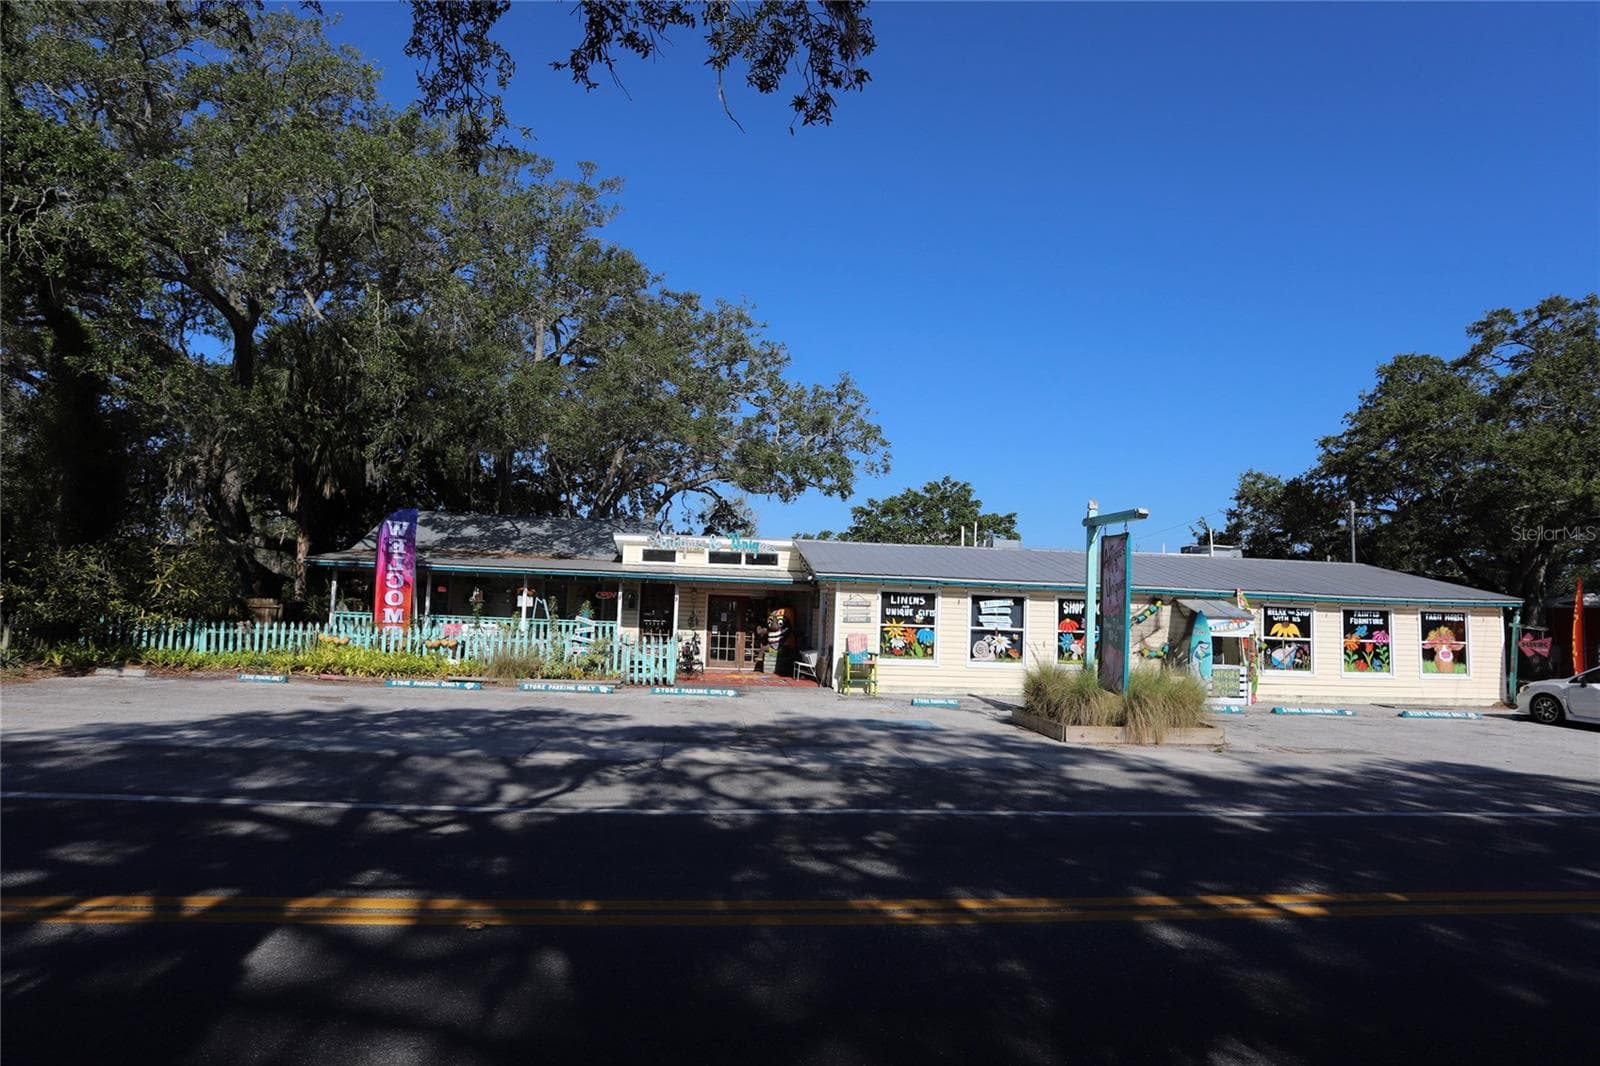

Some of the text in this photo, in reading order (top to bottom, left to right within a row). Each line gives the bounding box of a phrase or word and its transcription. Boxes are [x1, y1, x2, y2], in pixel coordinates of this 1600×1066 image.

[708, 533, 722, 551] &
[890, 594, 926, 605] LINENS
[885, 607, 914, 616] UNIQUE
[1063, 601, 1085, 614] SHOP
[1267, 608, 1287, 616] RELAX
[1350, 617, 1384, 625] FURNITURE
[655, 687, 679, 695] STORE
